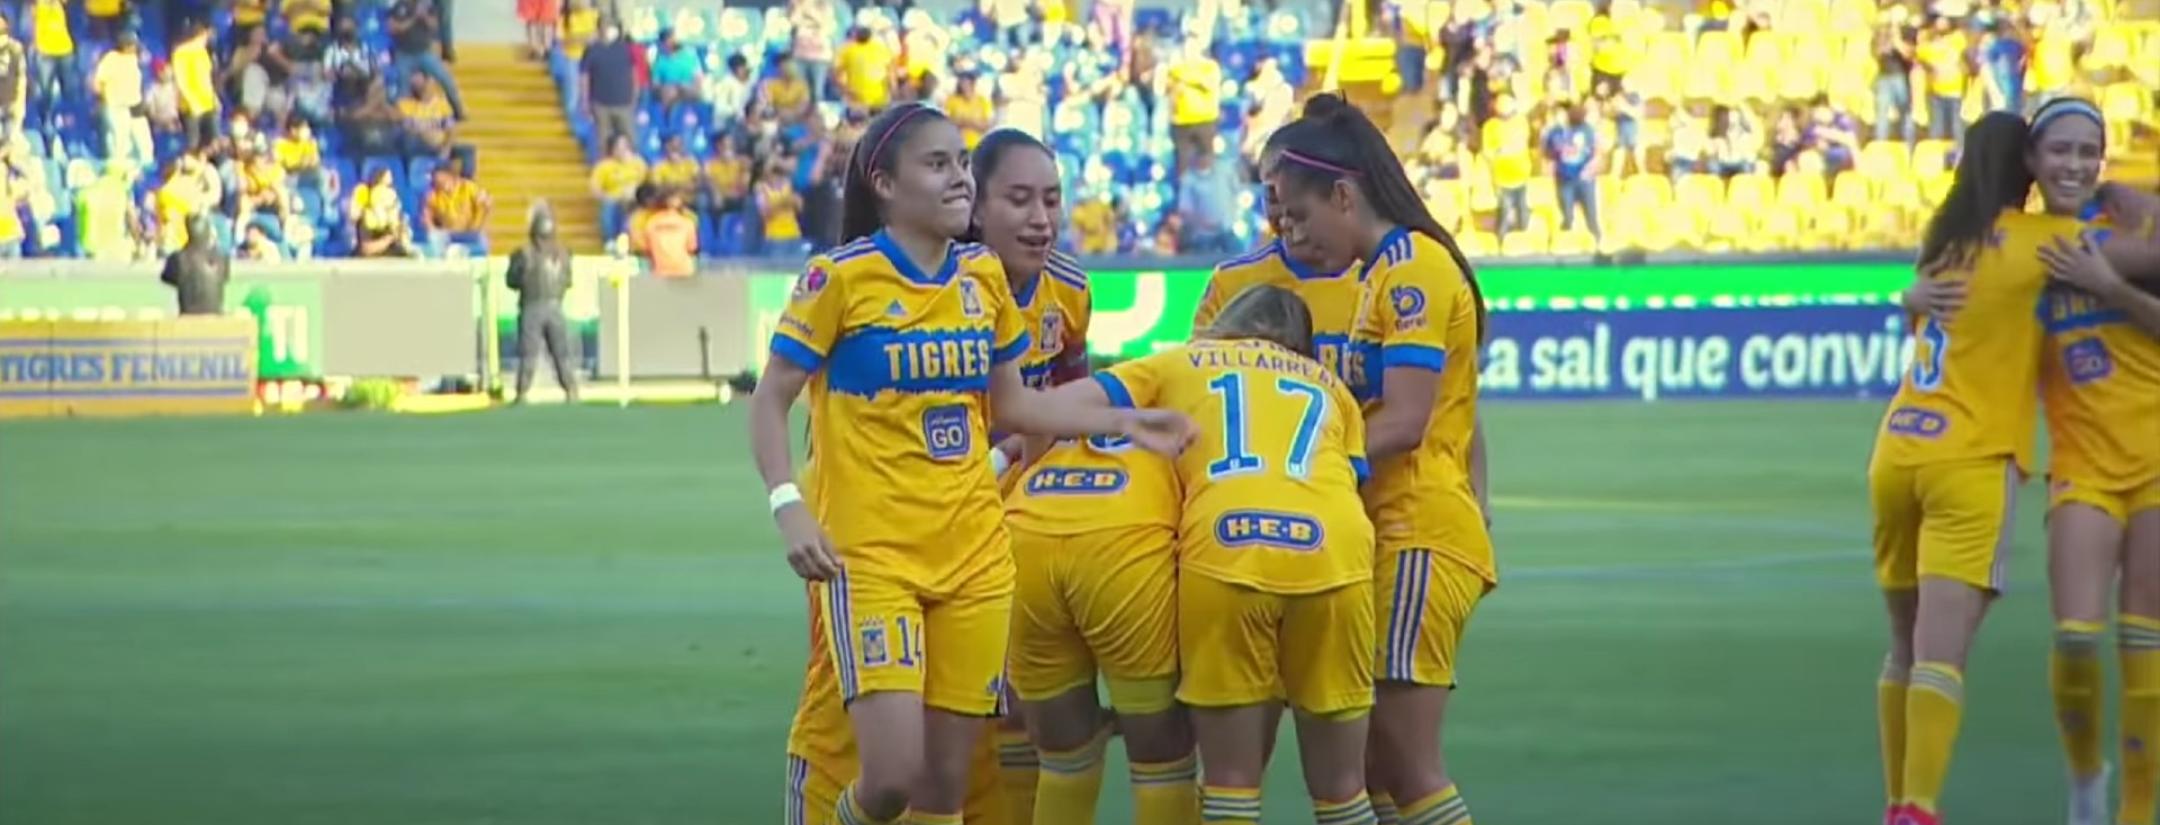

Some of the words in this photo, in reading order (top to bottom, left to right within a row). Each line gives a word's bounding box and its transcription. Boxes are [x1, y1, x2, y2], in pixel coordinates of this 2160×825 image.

[0, 354, 105, 383] TIGRES
[109, 353, 249, 382] FEMENIL
[884, 339, 990, 381] TIGRES
[1477, 337, 1520, 389] a
[1529, 321, 1611, 389] sal
[1621, 334, 1732, 402] que
[931, 425, 963, 448] GO
[1207, 369, 1328, 479] 17
